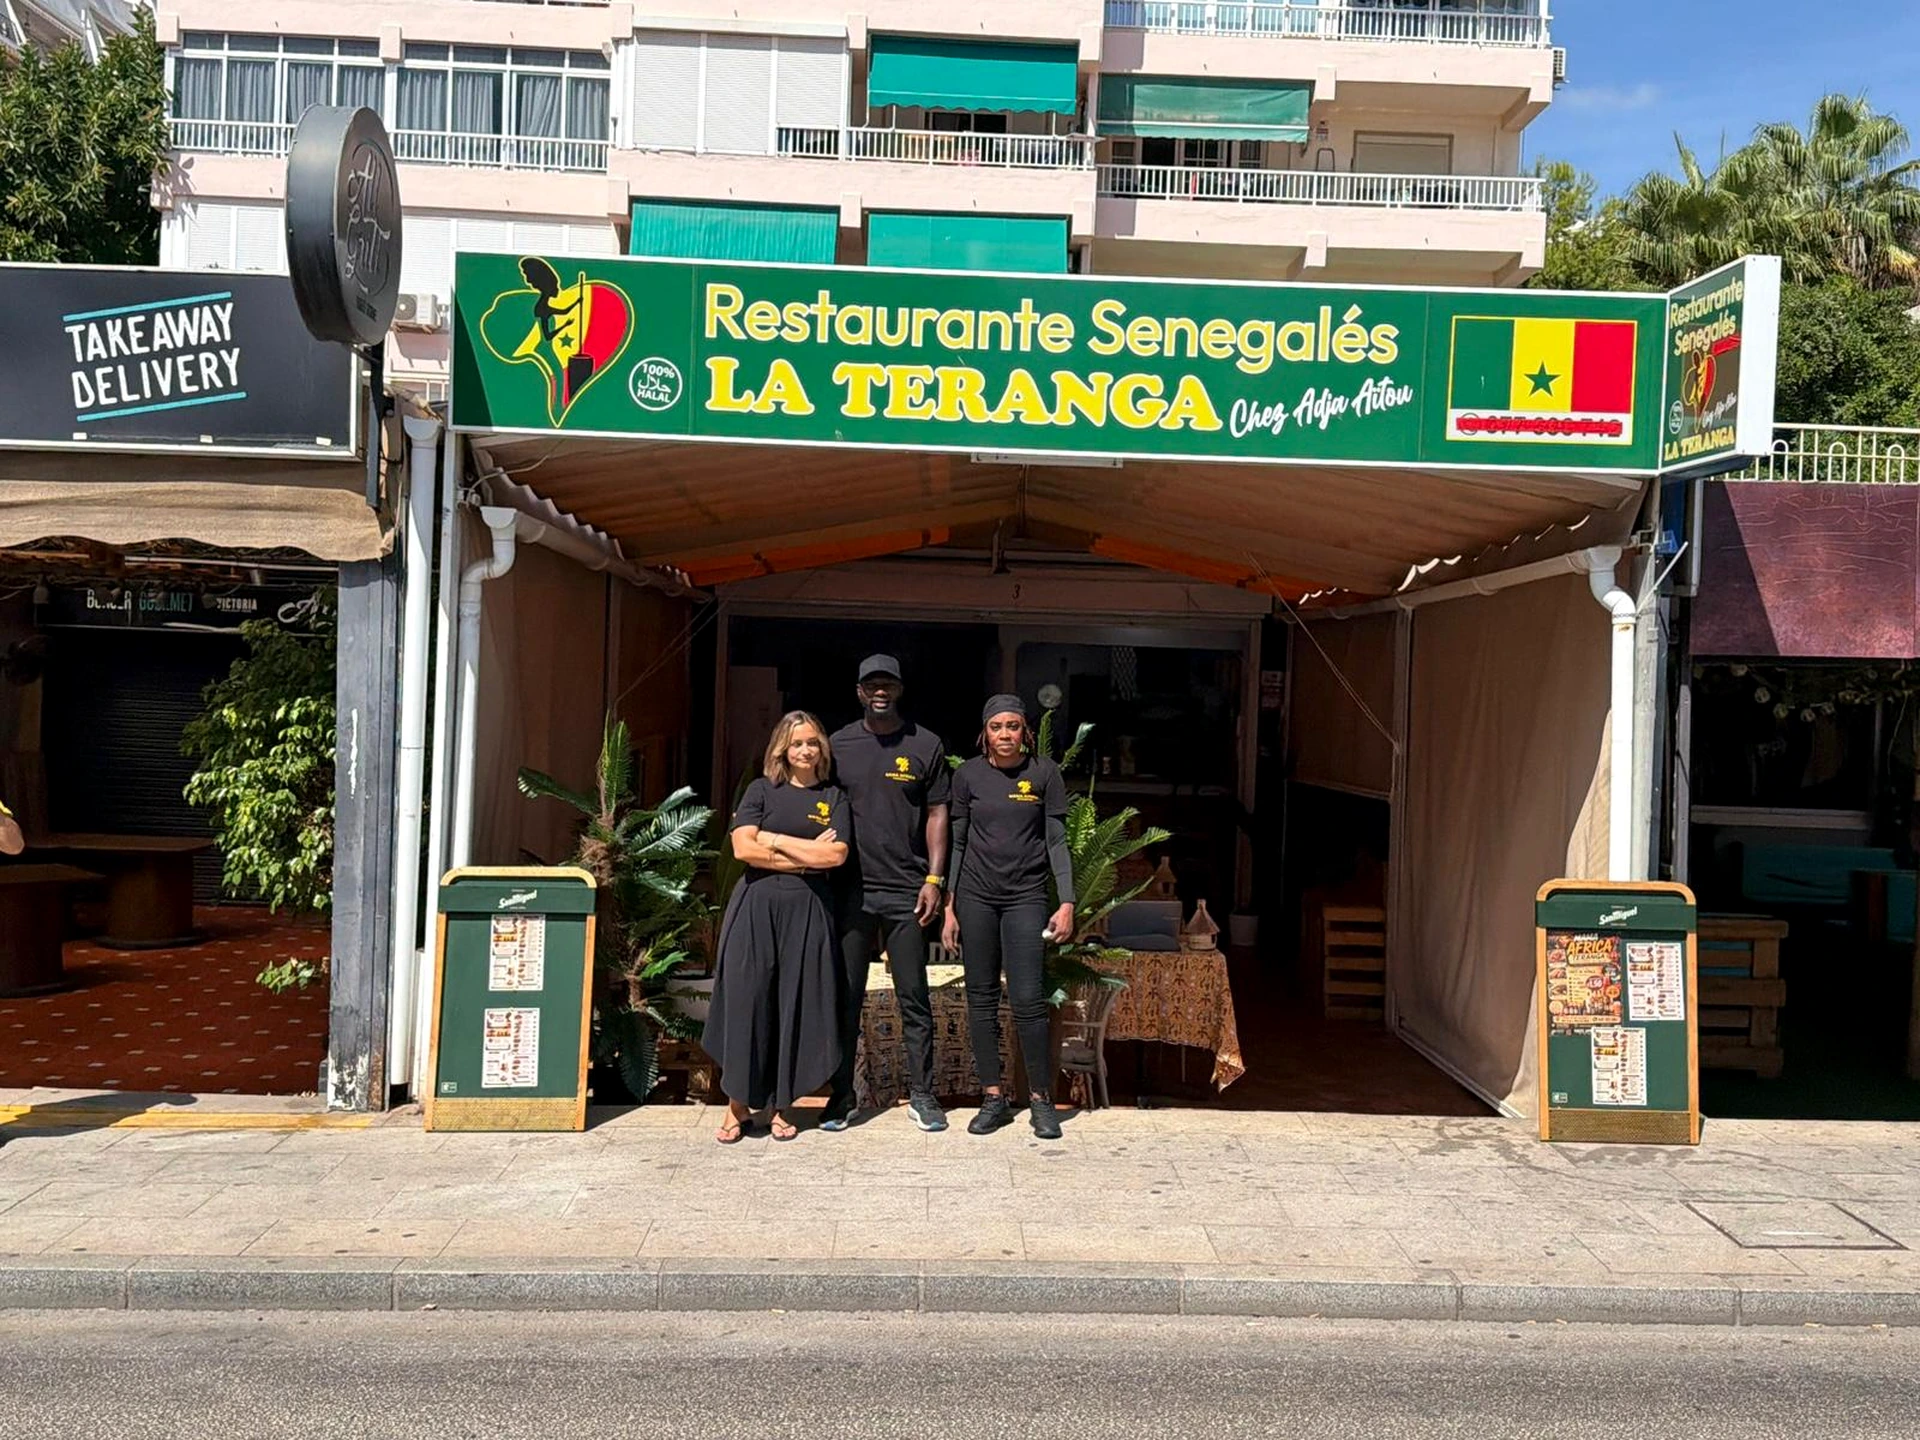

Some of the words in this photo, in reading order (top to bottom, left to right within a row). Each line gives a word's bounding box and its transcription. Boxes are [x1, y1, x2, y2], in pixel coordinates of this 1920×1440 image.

[1670, 276, 1744, 330] Restaurante
[704, 282, 1075, 353] Restaurante
[1087, 298, 1400, 375] Senegalés
[1673, 309, 1737, 356] Senegalés
[71, 347, 241, 409] DELIVERY
[637, 373, 672, 394] حلال
[642, 363, 676, 379] 100%
[704, 355, 816, 415] LA
[832, 362, 1223, 432] TERANGA
[637, 388, 671, 403] HALAL
[1229, 398, 1289, 438] Chez
[1293, 387, 1350, 430] Adja
[1664, 441, 1680, 461] LA
[1681, 425, 1735, 457] TERANGA
[1566, 939, 1612, 956] AFRICA
